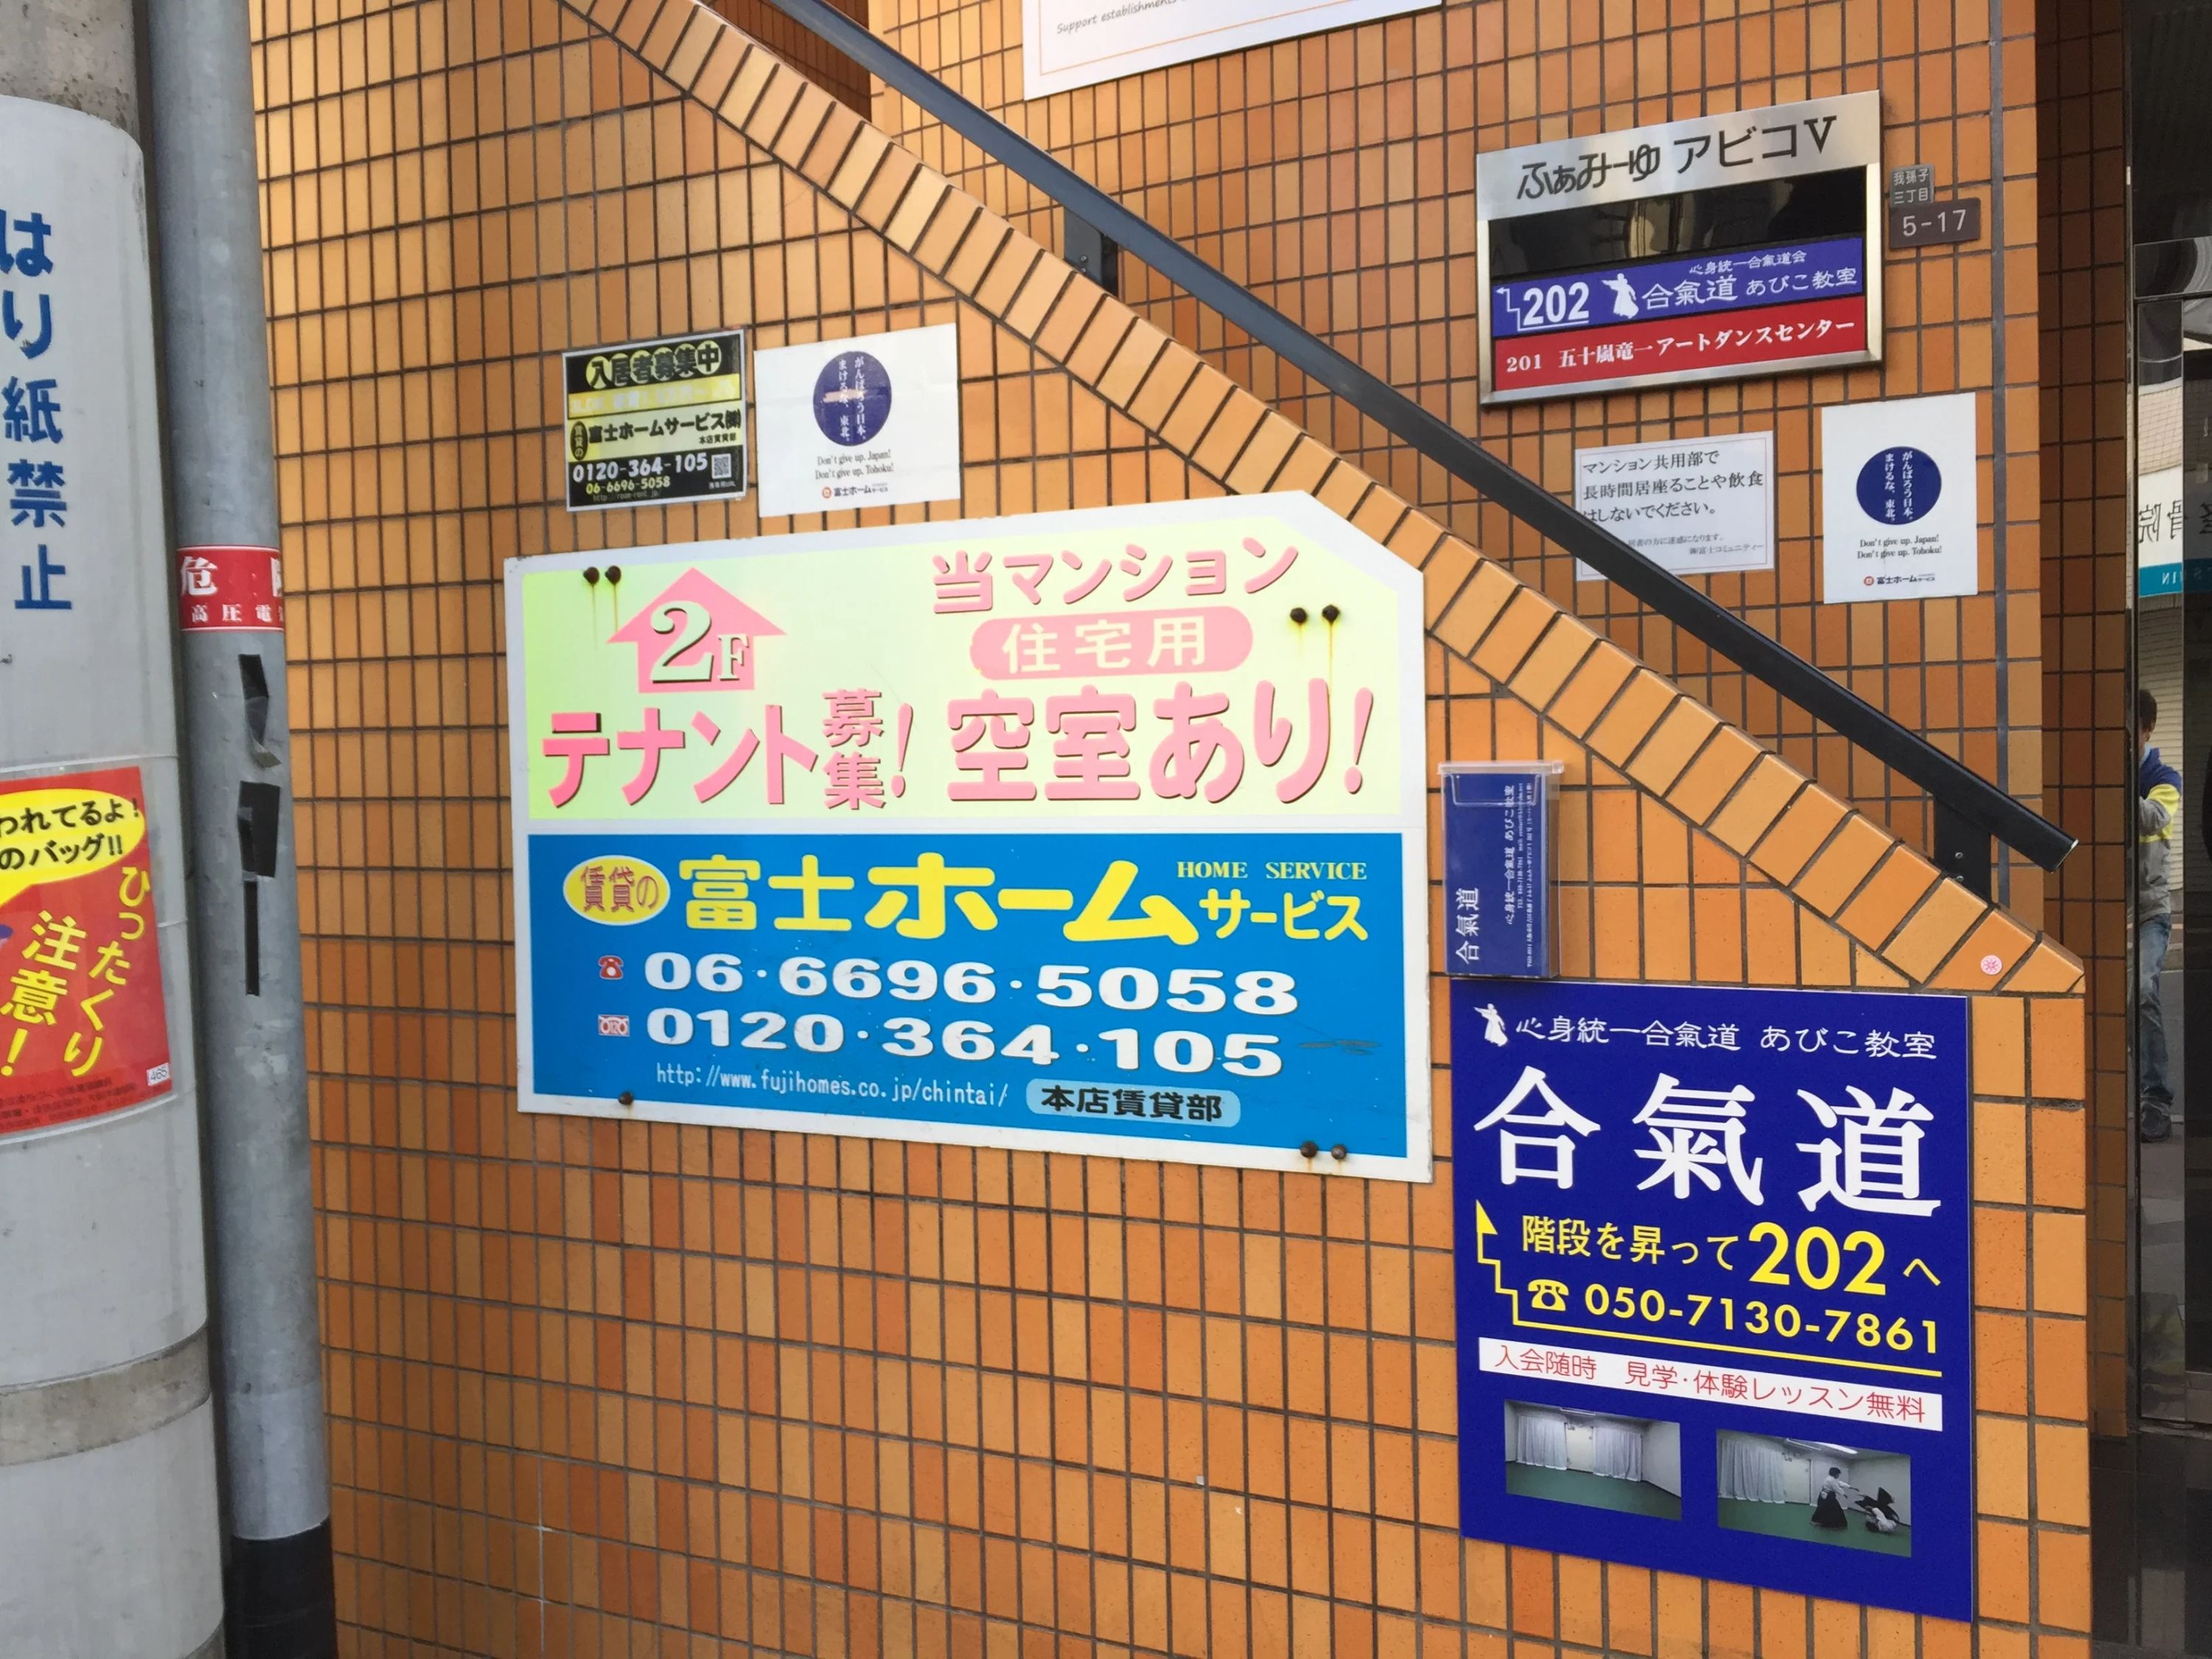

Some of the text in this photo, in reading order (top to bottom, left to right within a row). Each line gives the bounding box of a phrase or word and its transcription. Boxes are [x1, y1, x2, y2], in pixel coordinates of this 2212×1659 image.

[1057, 15, 1098, 34] Support
[1517, 144, 1660, 201] ふぁみーゆ
[1893, 167, 1930, 187] 我孫子
[1893, 187, 1930, 205] 三丁目
[1902, 209, 1967, 237] 5-17
[1523, 281, 1590, 327] 202
[1746, 267, 1857, 296] あびこ教室
[1506, 319, 1856, 372] 201 五十嵐竜一アートダンスセンター
[0, 209, 72, 610] はり紙禁止
[572, 452, 709, 483] 0120-364-105
[815, 469, 835, 479] Don't
[836, 468, 851, 479] give
[866, 463, 894, 474] Tohoku!
[817, 455, 837, 465] Don't
[838, 453, 853, 465] give
[868, 449, 891, 462] Japan!
[1582, 449, 1720, 475] マンション共用部で
[585, 476, 671, 495] 06-6696-5058
[1583, 470, 1764, 501] 長時間居座ることや飲食
[1902, 451, 1913, 521] がんばろう日本。
[1857, 550, 1879, 559] Don't
[1880, 549, 1896, 559] give
[1912, 546, 1942, 555] Tohoku!
[1860, 538, 1881, 547] Don't
[1882, 538, 1898, 547] give
[1914, 534, 1939, 544] Japan!
[932, 537, 1298, 616] 当マンション
[650, 606, 749, 684] 2F
[1002, 613, 1208, 673] 住宅用
[947, 679, 1374, 804] 空室あり!
[580, 864, 659, 915] 賃貸の
[1177, 861, 1368, 880] HOME SERVICE
[1, 910, 88, 1077] 注意!
[63, 866, 150, 1077] ひったくり
[1515, 1017, 1938, 1060] 心身統一合氣道 あびこ教室
[655, 1062, 1009, 1107] http://www.fujihomes.co.jp/chintai/
[1041, 1084, 1222, 1123] 本店賃貸部
[1585, 1282, 1938, 1354] 050-7130-7861
[1495, 1346, 1926, 1423] 入会随時 見学・体験レッスン無料
